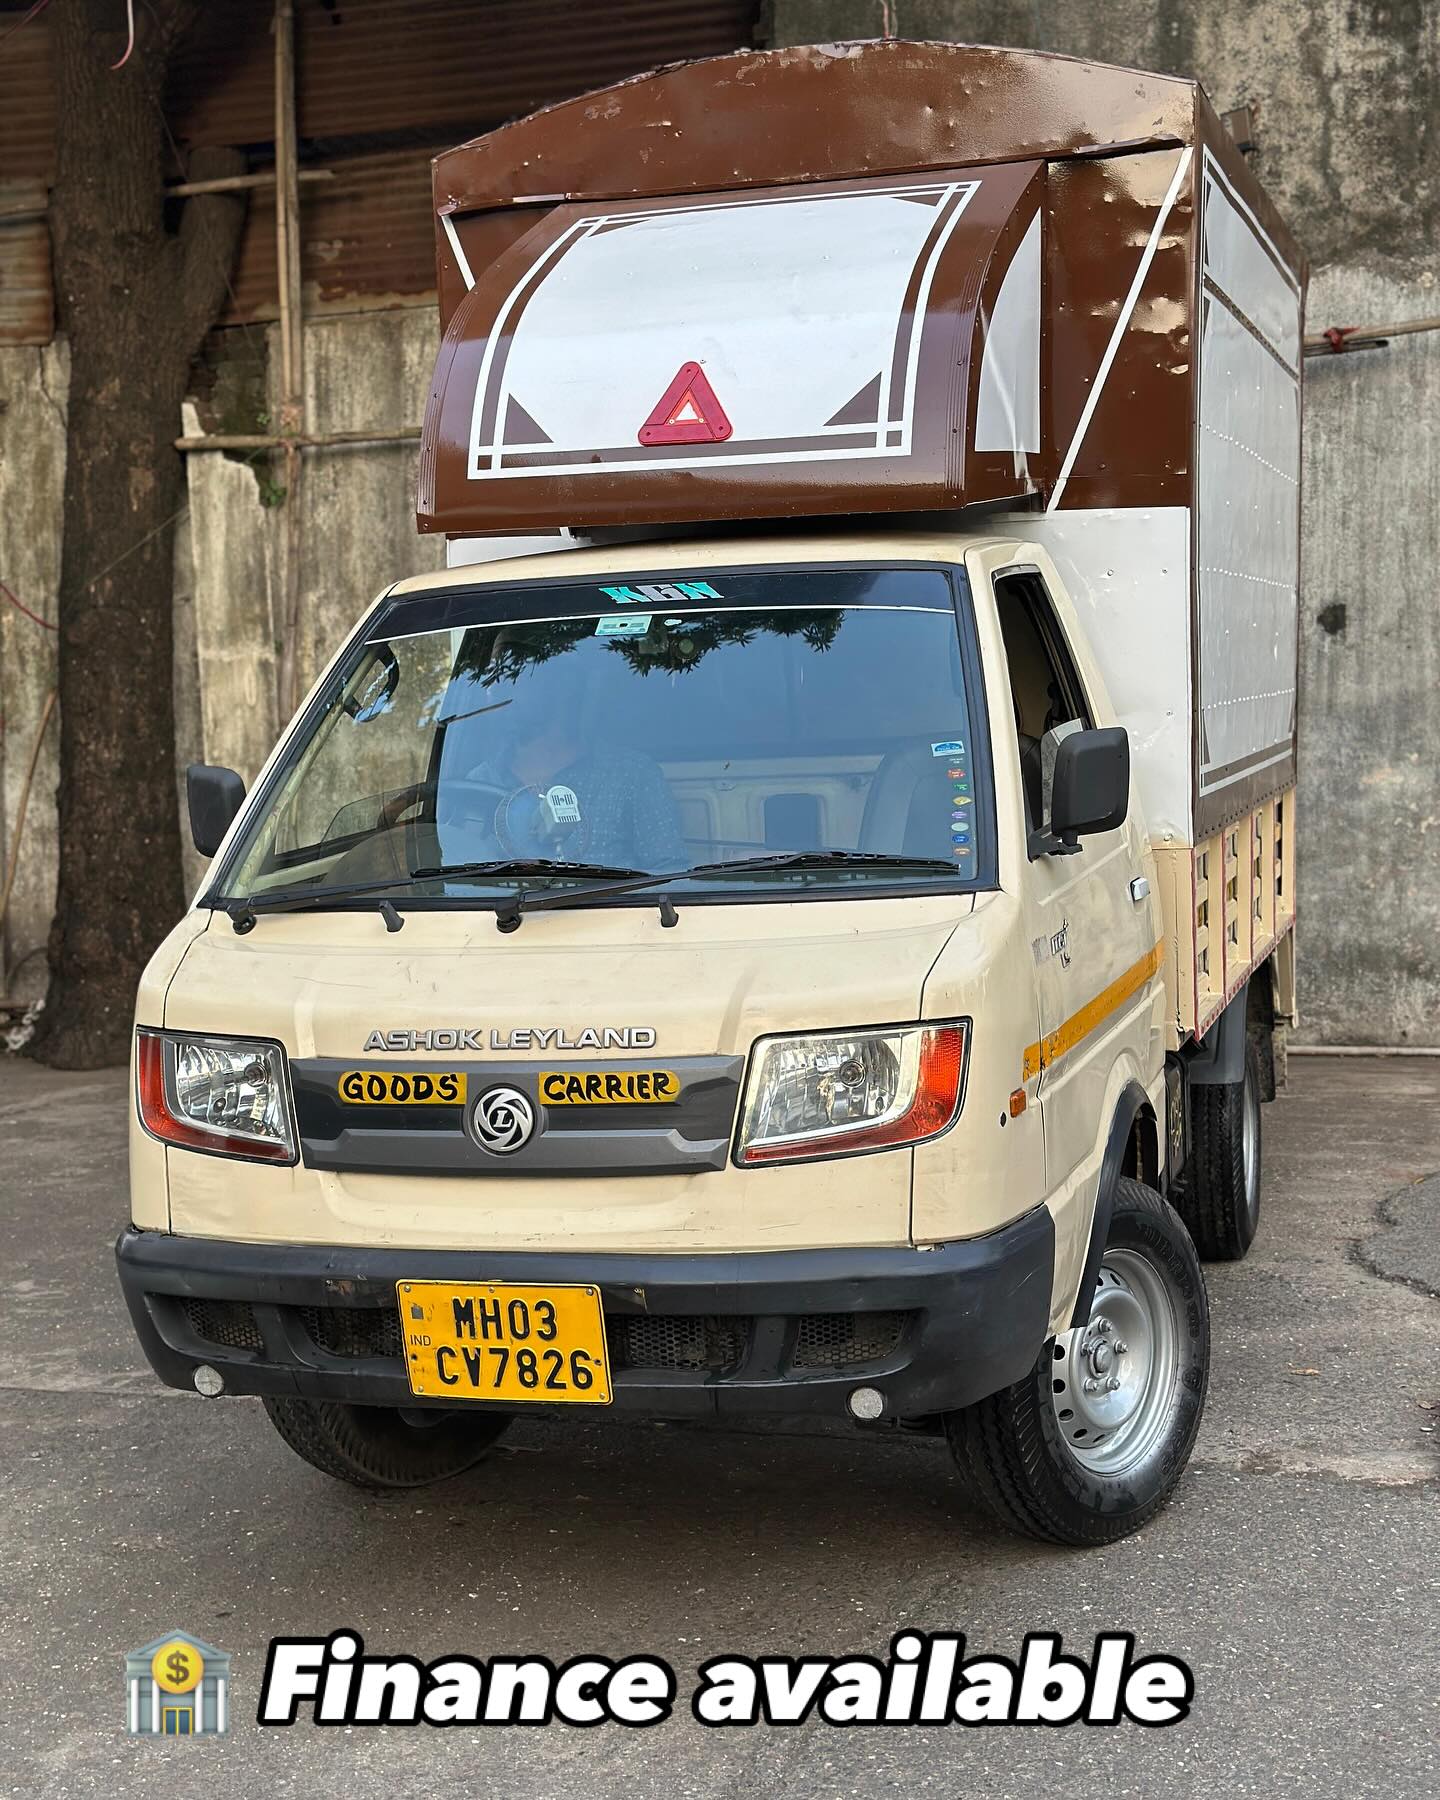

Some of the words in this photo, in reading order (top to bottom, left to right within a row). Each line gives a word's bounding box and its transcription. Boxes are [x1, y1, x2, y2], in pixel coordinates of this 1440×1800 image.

[598, 582, 725, 604] KGN
[363, 1028, 482, 1051] ASHOK
[490, 1027, 657, 1050] LEYLAND
[343, 1072, 460, 1102] GOODS
[542, 1071, 678, 1104] CARRIER
[452, 1297, 558, 1341] MH03
[410, 1334, 432, 1347] IND
[436, 1346, 594, 1390] CV7826
